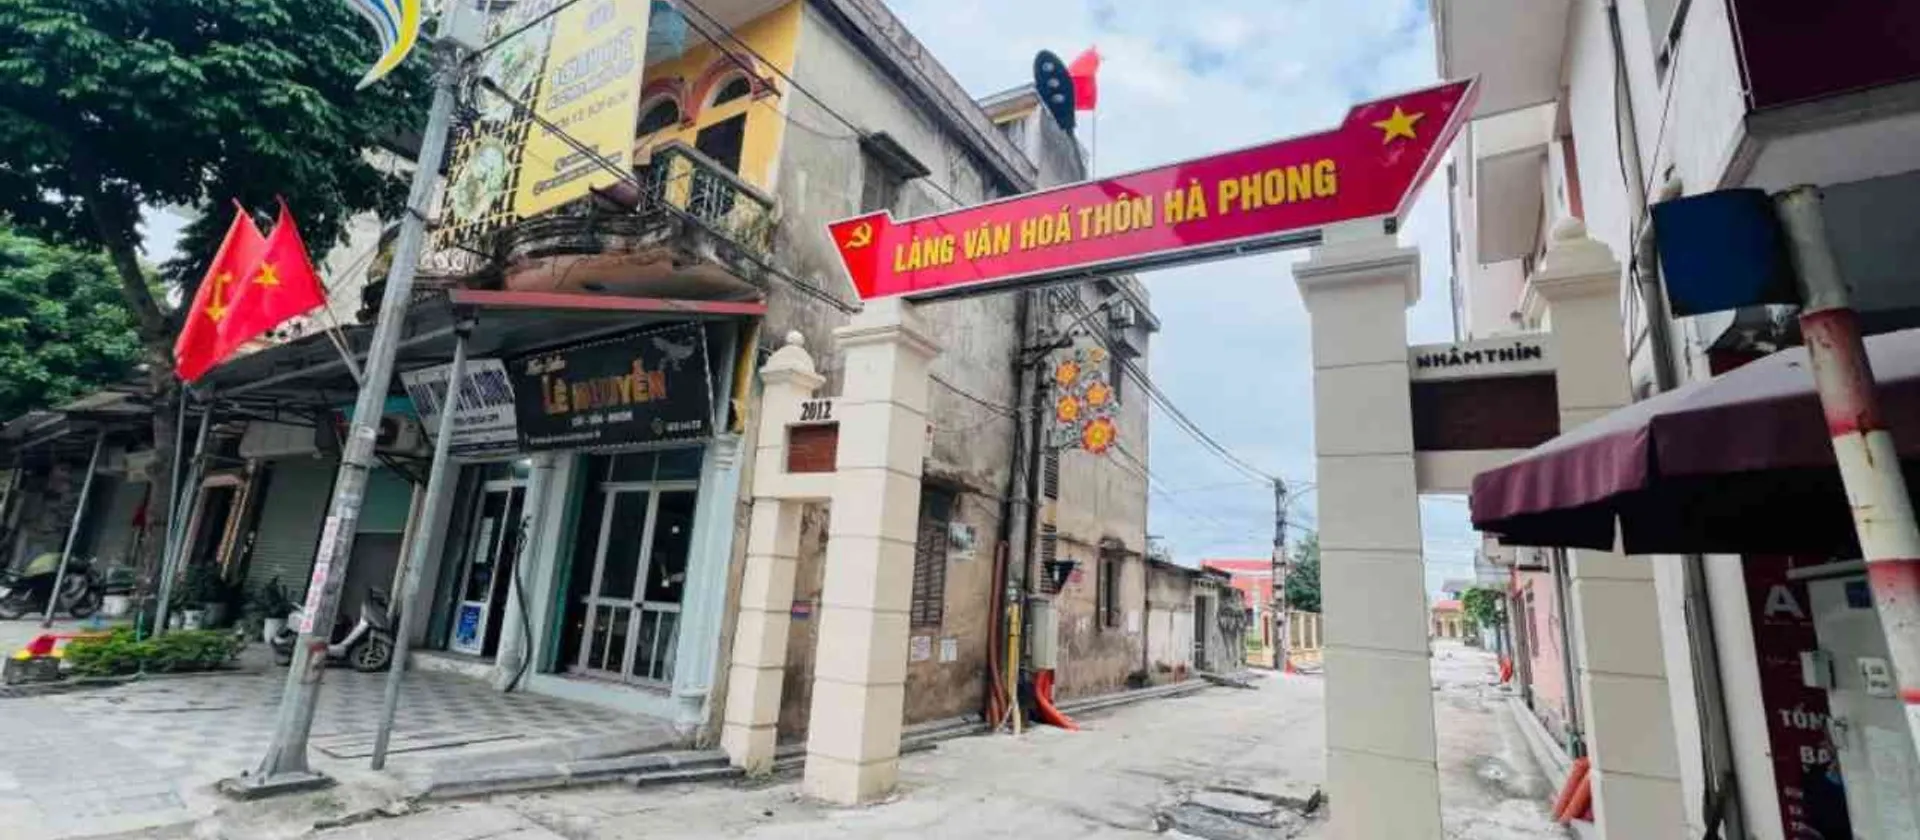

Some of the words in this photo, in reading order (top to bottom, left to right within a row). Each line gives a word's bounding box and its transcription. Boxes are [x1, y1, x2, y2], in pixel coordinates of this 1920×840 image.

[893, 234, 955, 272] LÀNG
[963, 219, 1012, 259] VĂN
[1020, 204, 1072, 251] HOÁ
[1077, 191, 1154, 240] THÔN
[1164, 177, 1209, 225] HÀ
[1218, 157, 1338, 216] PHONG
[799, 399, 833, 422] 2012
